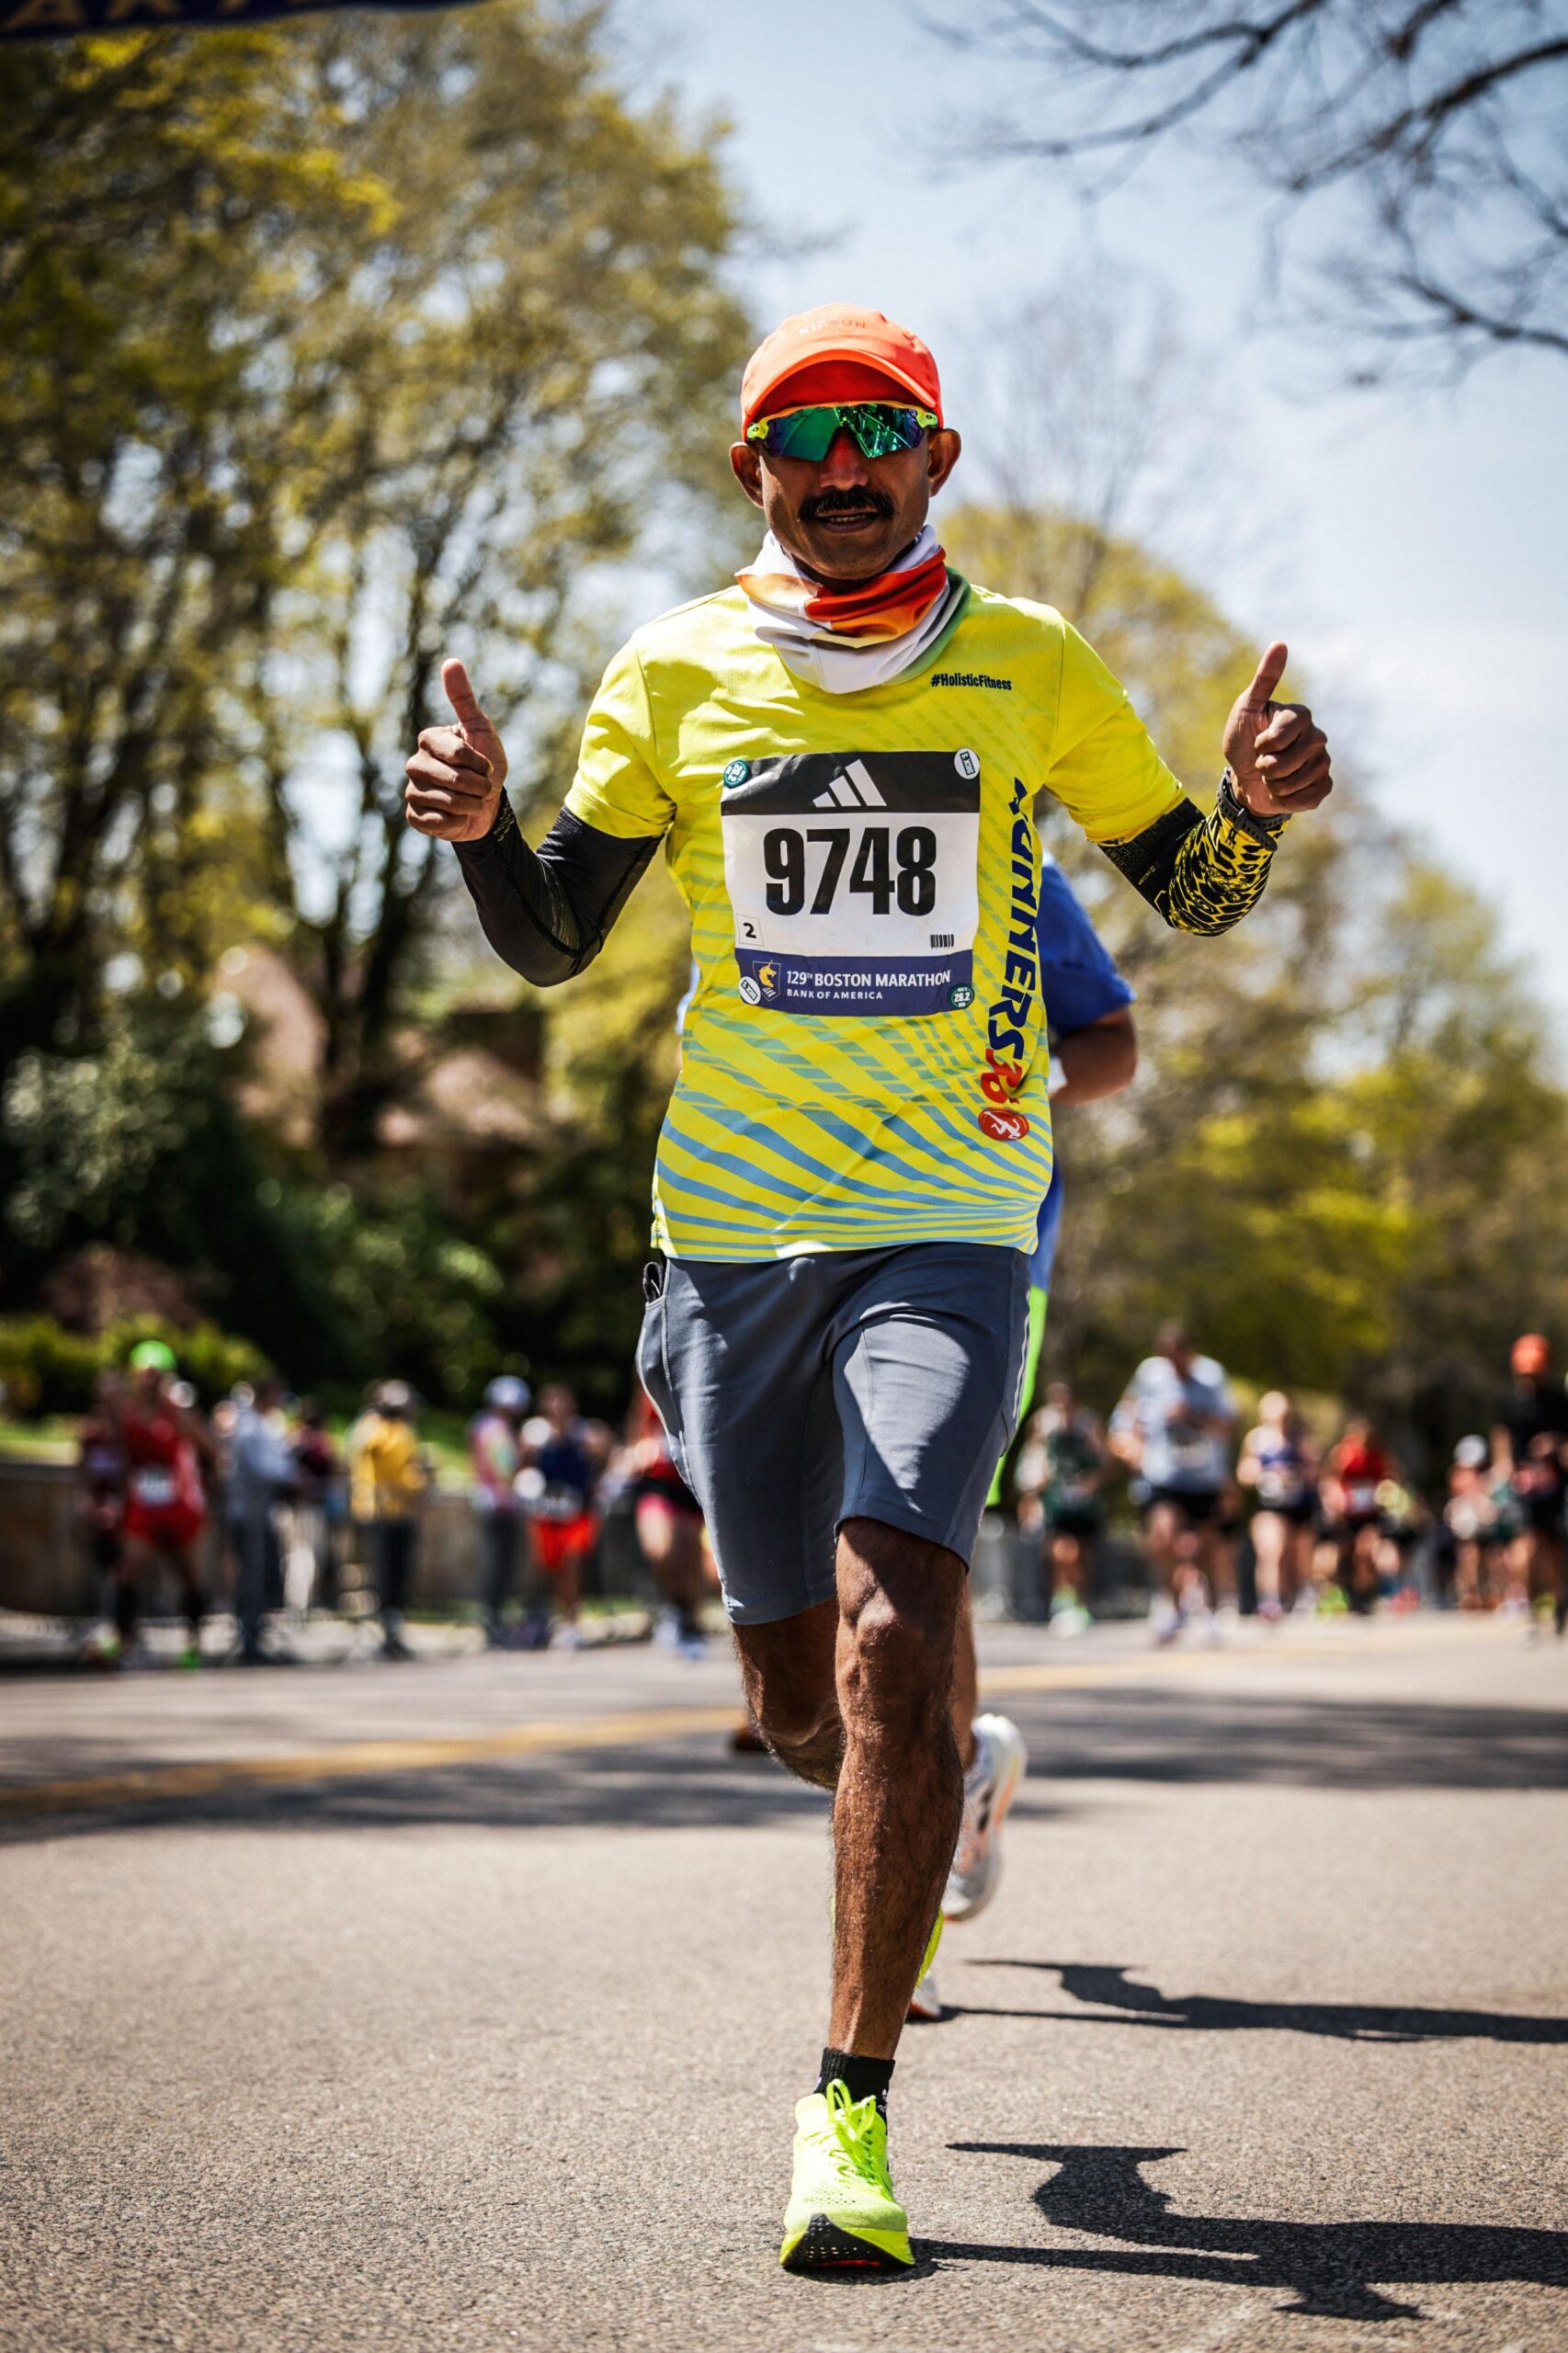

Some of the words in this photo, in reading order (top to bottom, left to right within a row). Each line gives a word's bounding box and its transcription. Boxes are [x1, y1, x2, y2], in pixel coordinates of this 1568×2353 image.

[930, 672, 1012, 690] #HolisticFitness
[763, 826, 937, 916] 9748
[743, 922, 756, 939] 2
[814, 973, 871, 987] BOSTON
[875, 970, 951, 987] MARATHON
[787, 988, 814, 999] BANK
[816, 991, 831, 999] OF
[833, 991, 883, 1000] AMERICA
